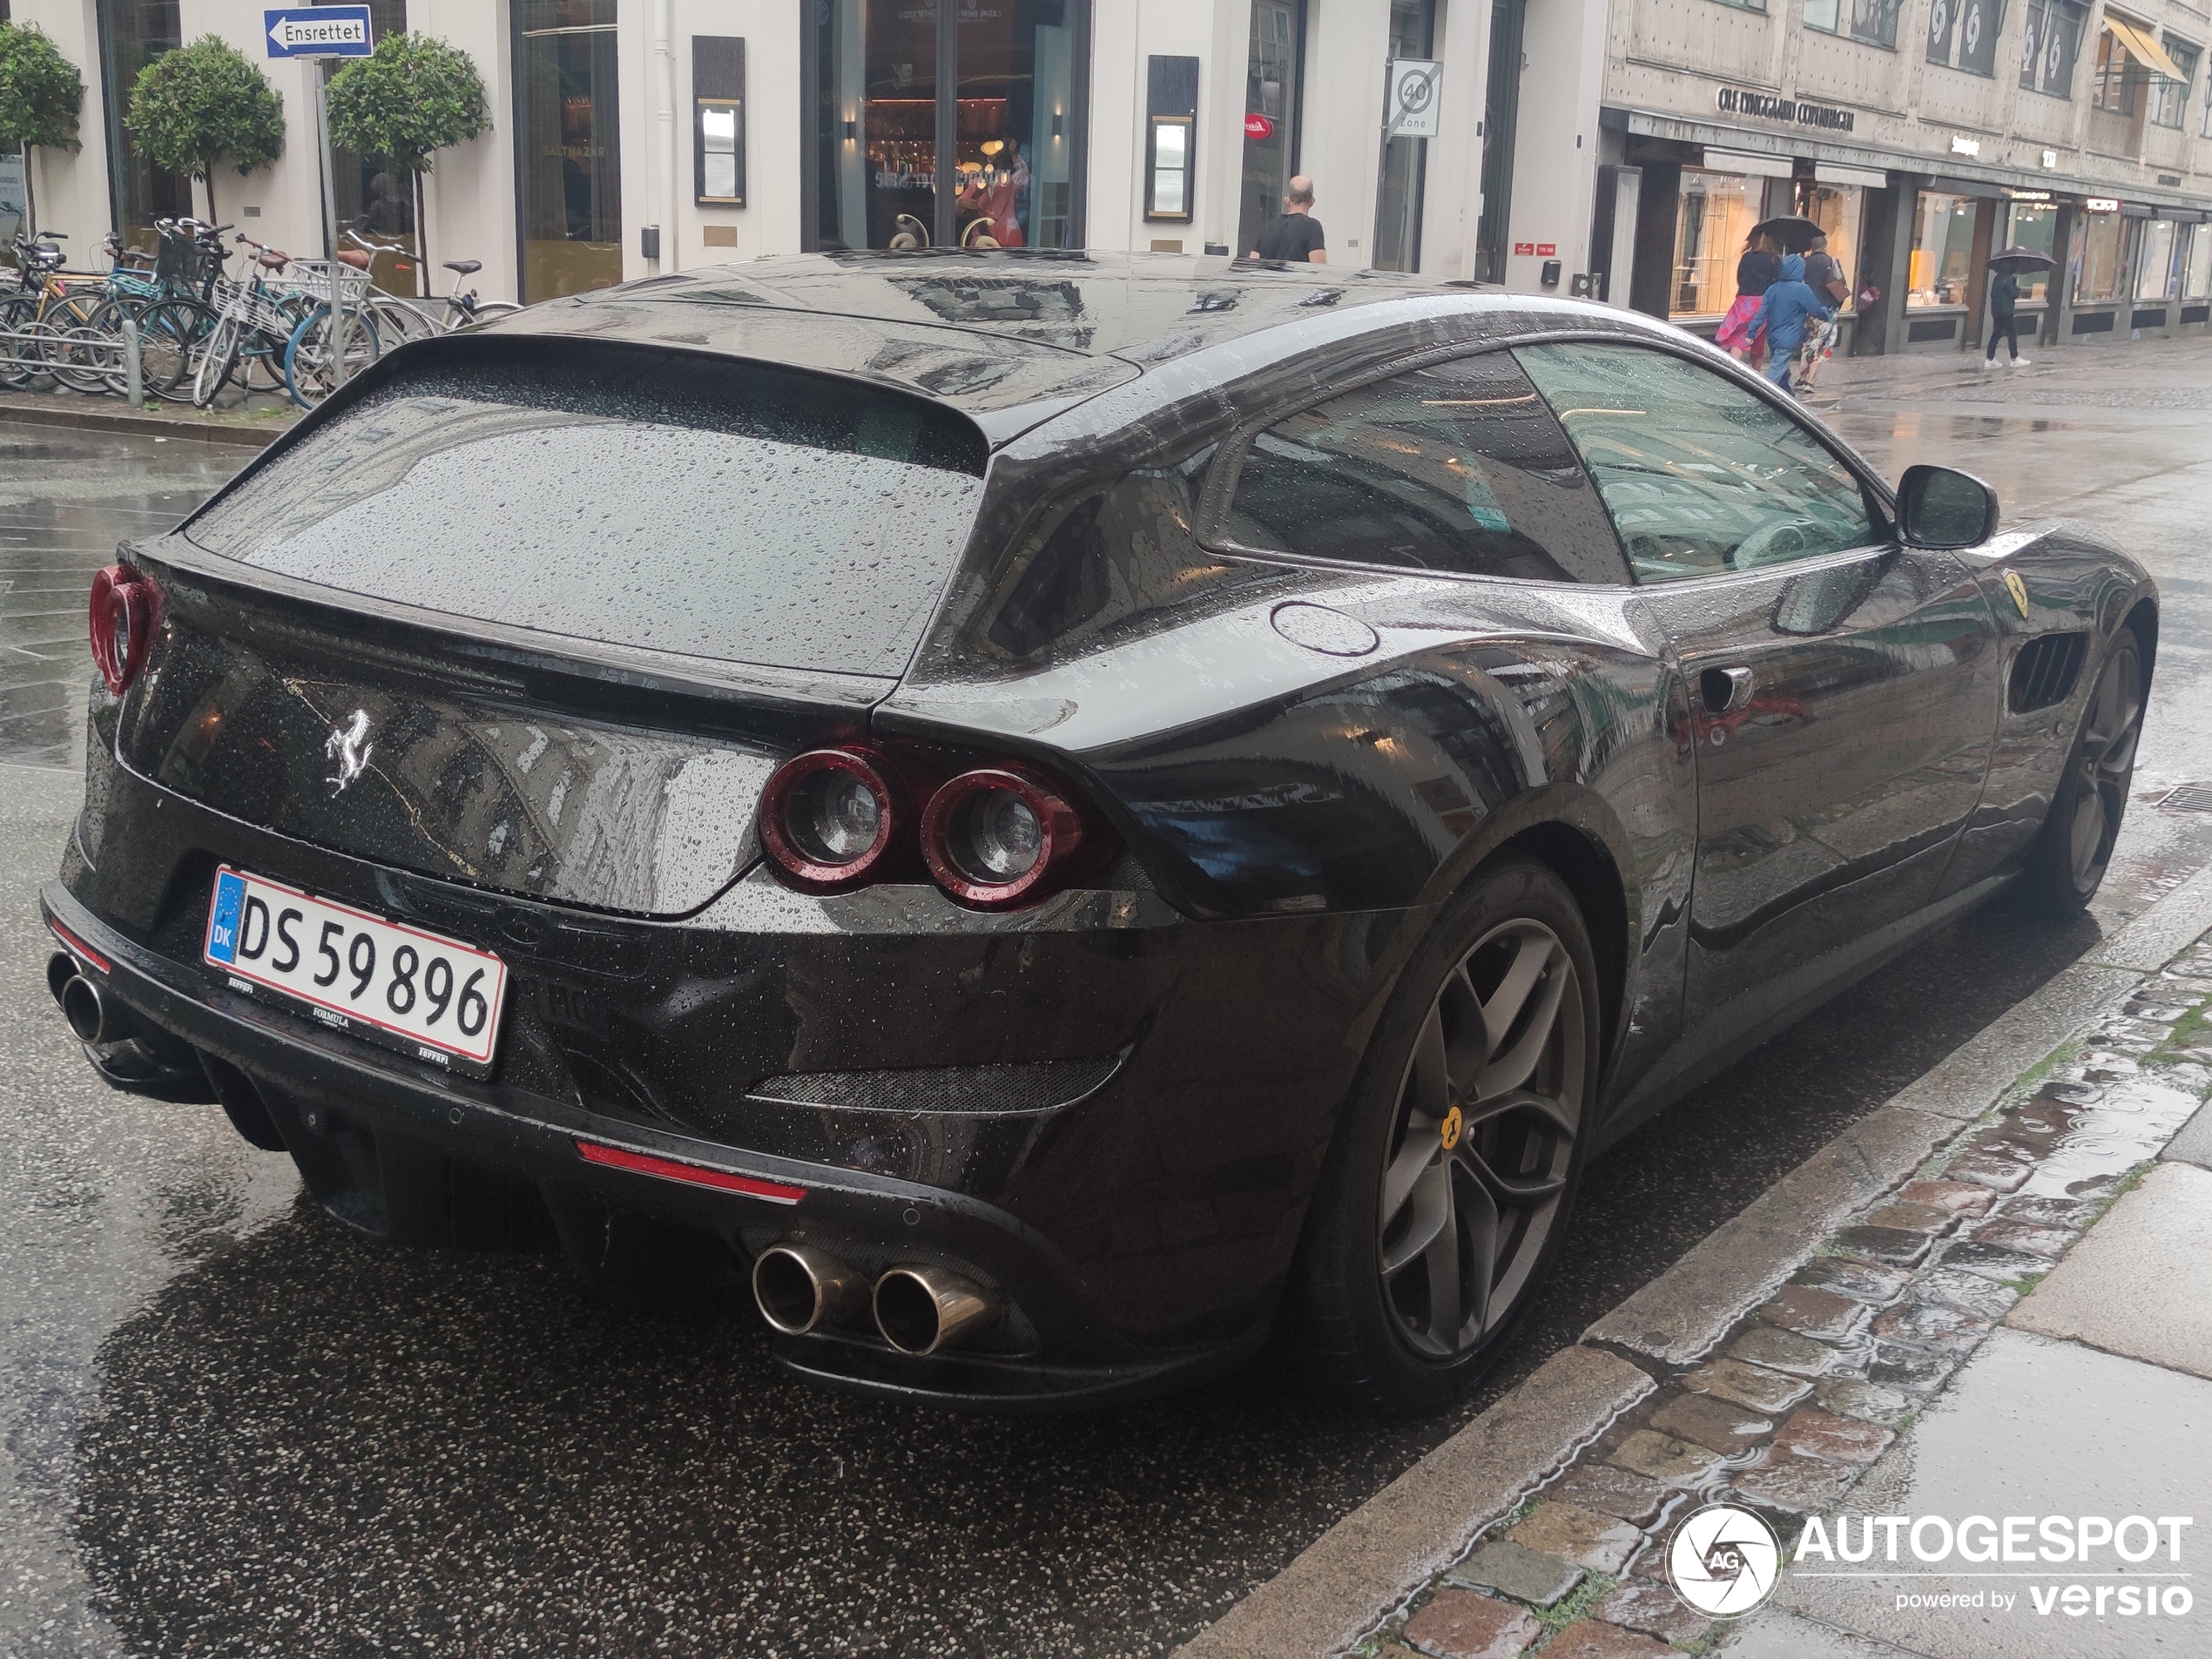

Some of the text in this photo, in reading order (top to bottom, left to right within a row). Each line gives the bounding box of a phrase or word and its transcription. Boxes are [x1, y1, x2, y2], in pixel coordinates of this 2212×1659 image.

[285, 24, 361, 41] Ensrettet
[1404, 84, 1426, 100] 40
[1719, 88, 1854, 132] OLE LYNGGAARD COPENHAGEN
[543, 145, 605, 157] BALTHAZAR
[213, 924, 233, 948] DK
[239, 894, 303, 973] DS
[314, 920, 376, 1001] 59
[387, 944, 488, 1037] 896
[228, 977, 253, 994] Ferrari
[313, 1007, 349, 1028] FORMULA
[419, 1047, 448, 1064] Ferrari
